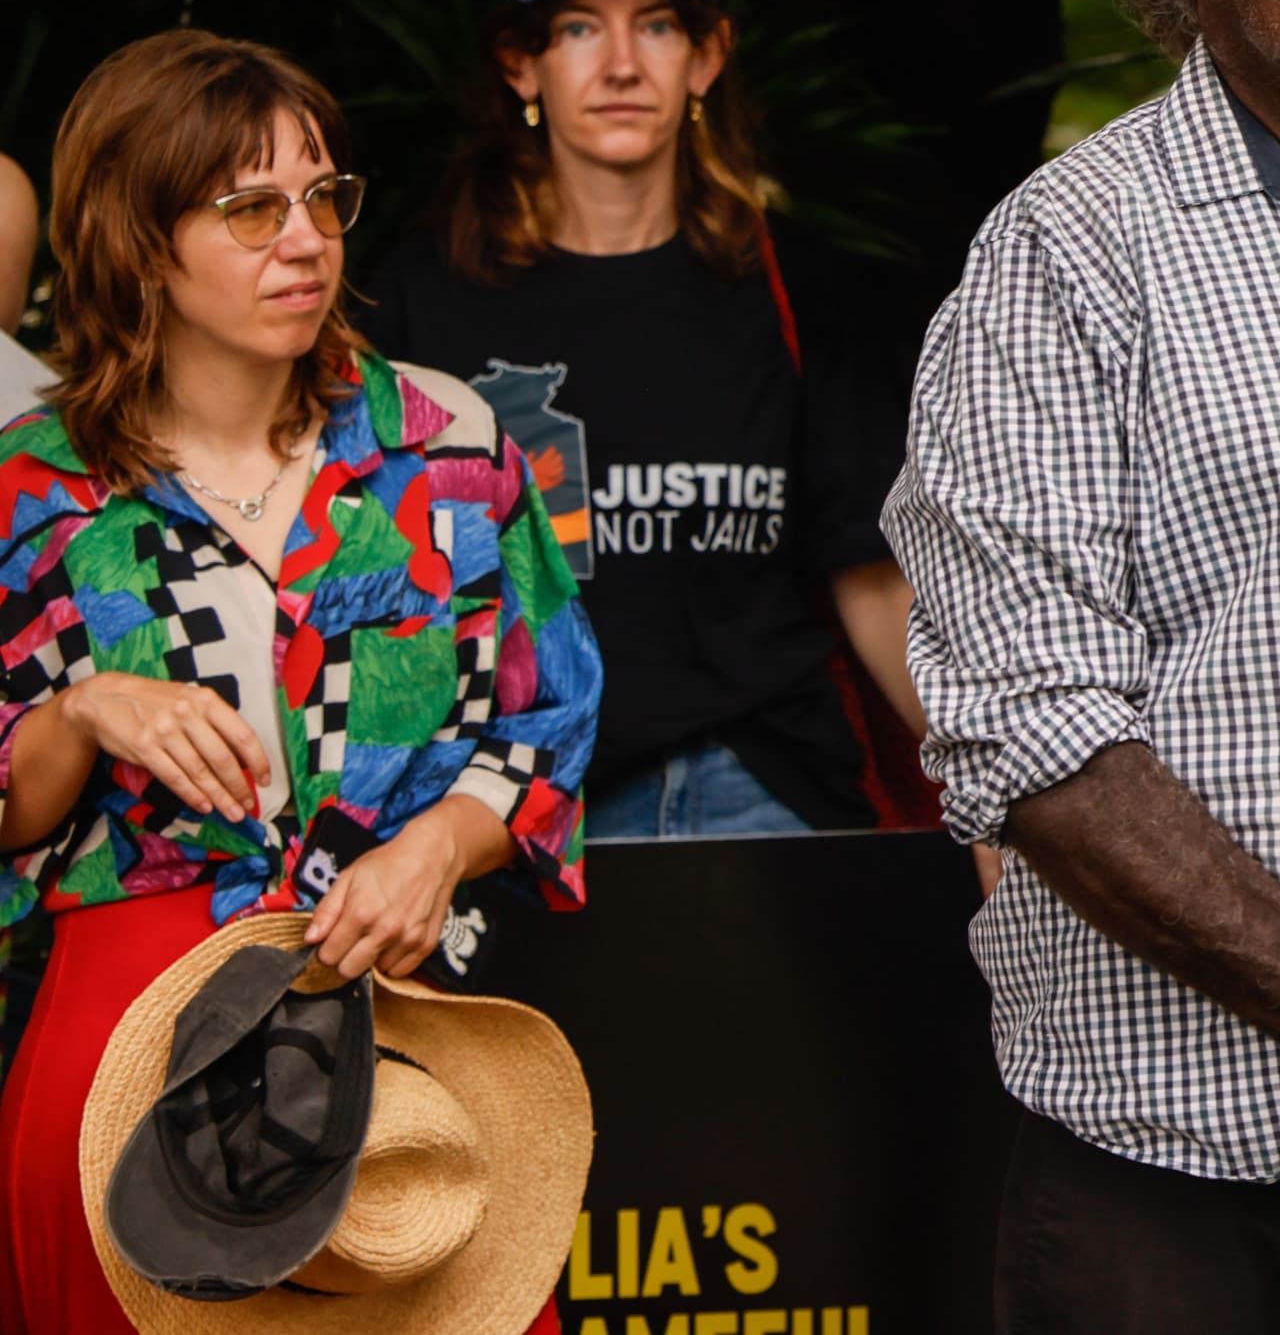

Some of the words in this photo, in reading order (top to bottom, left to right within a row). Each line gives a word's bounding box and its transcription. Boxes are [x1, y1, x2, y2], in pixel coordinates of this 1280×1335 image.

[593, 463, 786, 510] JUSTICE
[595, 511, 680, 554] NOT
[691, 511, 783, 554] JAILS
